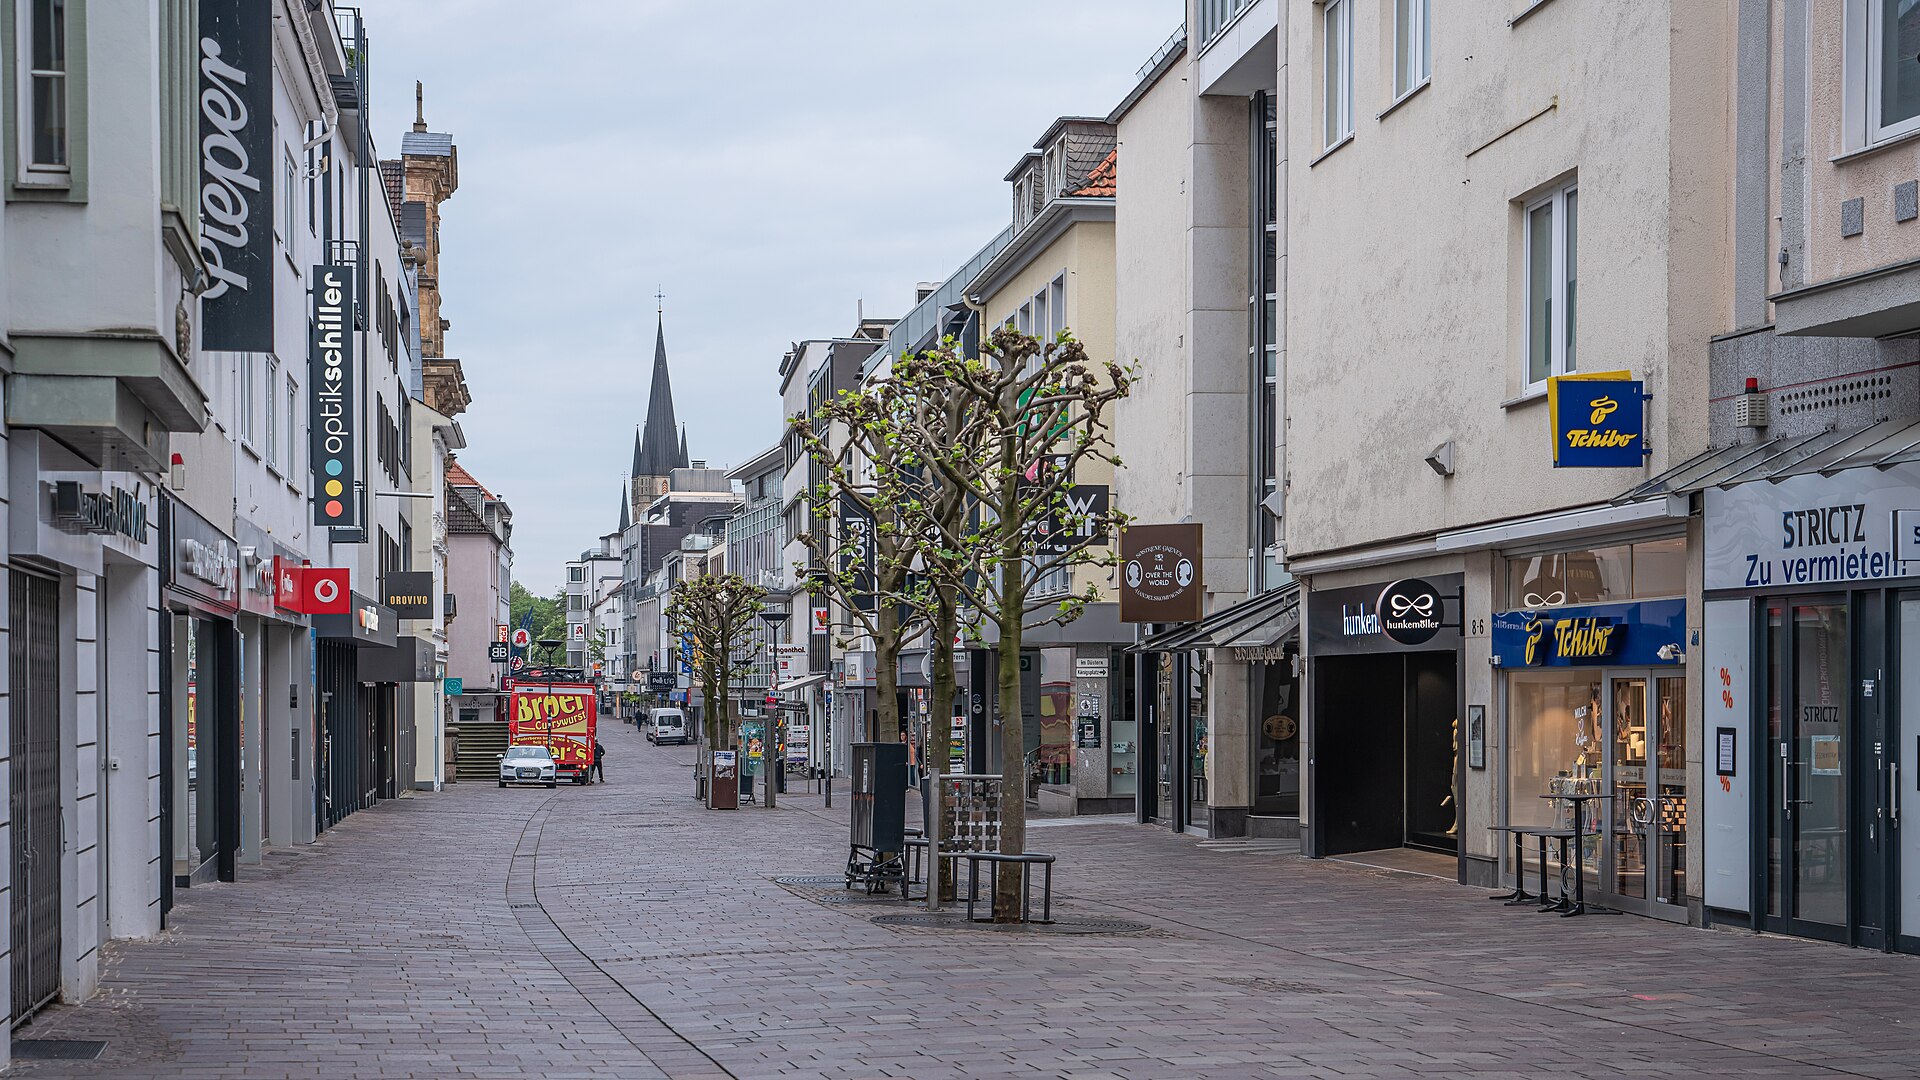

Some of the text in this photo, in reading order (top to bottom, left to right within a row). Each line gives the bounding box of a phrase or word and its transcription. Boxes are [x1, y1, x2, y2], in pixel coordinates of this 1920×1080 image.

[200, 36, 260, 300] pieper
[317, 272, 349, 454] optikschiller
[1566, 429, 1638, 448] Tchibo
[1782, 503, 1866, 550] STRICTZ
[1745, 545, 1907, 586] Zu vermieten!
[389, 595, 428, 605] OROVIVO
[1386, 619, 1440, 630] hunkemöller
[1471, 619, 1484, 635] 8-6
[1554, 617, 1614, 657] Tchibo
[768, 645, 806, 655] kngenthal.
[535, 711, 587, 730] Curywurst
[1803, 706, 1839, 723] STRICTZ
